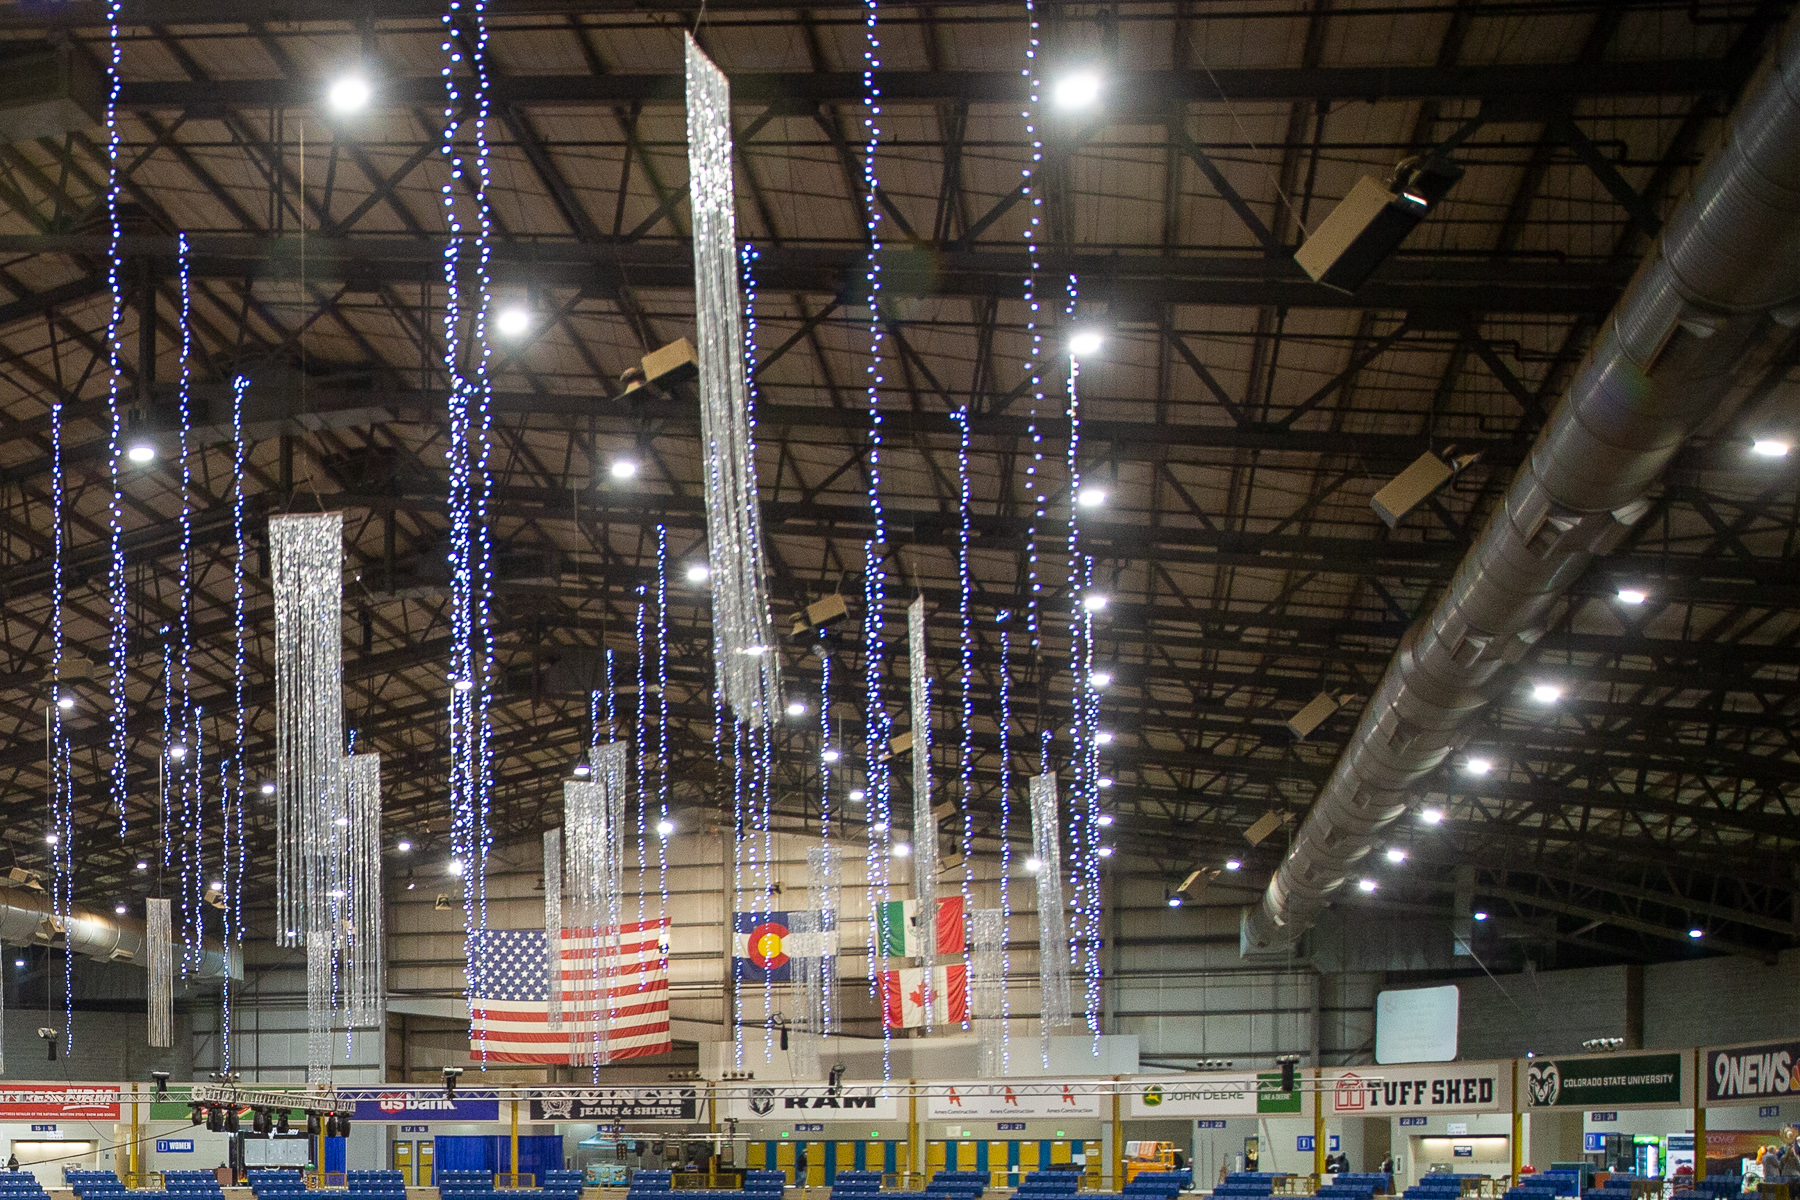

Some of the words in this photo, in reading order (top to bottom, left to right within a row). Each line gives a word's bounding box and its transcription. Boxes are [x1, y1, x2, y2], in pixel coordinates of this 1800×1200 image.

[1714, 1051, 1791, 1096] 9NEWS
[1563, 1077, 1601, 1088] COLORADO
[1603, 1075, 1626, 1086] STATE
[1627, 1074, 1674, 1085] UNIVERSITY
[1167, 1091, 1200, 1101] JOHN
[1203, 1090, 1244, 1100] DEERE
[1367, 1080, 1427, 1106] TUFF
[1431, 1077, 1494, 1105] SHED
[785, 1096, 876, 1109] RAM
[580, 1107, 618, 1117] JEANS
[621, 1107, 631, 1116] &
[634, 1107, 682, 1116] SHIRTS
[169, 1141, 192, 1150] WOMEN
